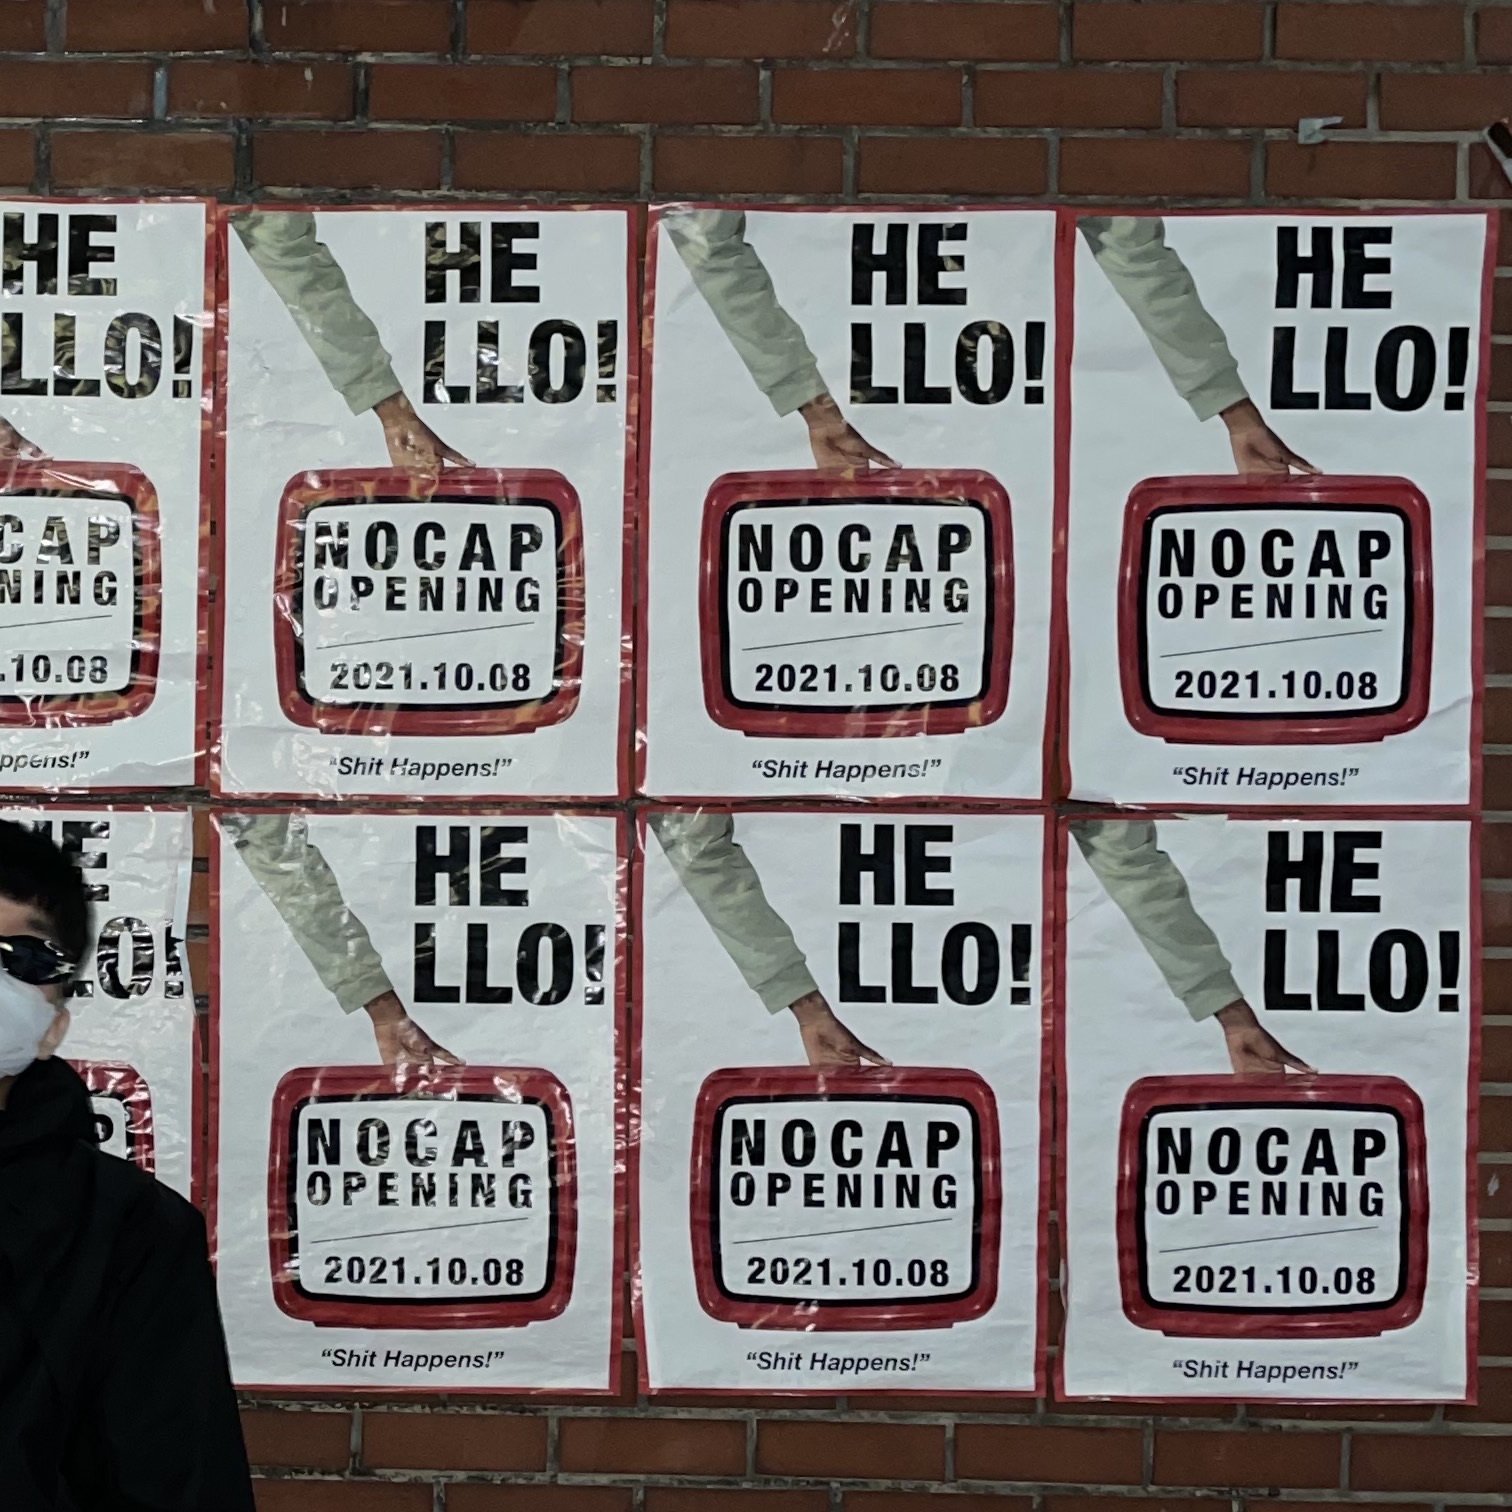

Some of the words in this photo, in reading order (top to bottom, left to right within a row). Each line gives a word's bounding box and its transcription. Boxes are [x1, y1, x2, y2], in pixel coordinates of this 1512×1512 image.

[2, 213, 117, 296] HE
[425, 222, 540, 303] HE
[852, 223, 967, 305] HE
[1275, 227, 1392, 309] HE
[1, 313, 193, 399] LLO!
[423, 319, 617, 404] LLO!
[850, 321, 1045, 405] LLO!
[1271, 325, 1469, 411] LLO!
[315, 521, 542, 571] NOCAP
[739, 524, 971, 572] NOCAP
[1160, 529, 1390, 578] NOCAP
[314, 576, 539, 612] OPENING
[739, 578, 968, 612] OPENING
[1158, 583, 1387, 619] OPENING
[331, 662, 530, 691] 2021.10.08
[756, 664, 959, 692] 2021.10.08
[1176, 671, 1377, 699] 2021.10.08
[415, 826, 528, 906] HE
[840, 824, 954, 906] HE
[1266, 831, 1382, 912] HE
[414, 923, 605, 1005] LLO!
[839, 922, 1031, 1005] LLO!
[1264, 929, 1459, 1012] LLO!
[308, 1118, 534, 1167] NOCAP
[731, 1119, 959, 1168] NOCAP
[1158, 1127, 1385, 1176] NOCAP
[307, 1171, 532, 1208] OPENING
[731, 1172, 956, 1208] OPENING
[1157, 1180, 1383, 1216] OPENING
[325, 1256, 523, 1286] 2021.10.08
[748, 1257, 948, 1286] 2021.10.08
[1174, 1266, 1374, 1294] 2021.10.08
